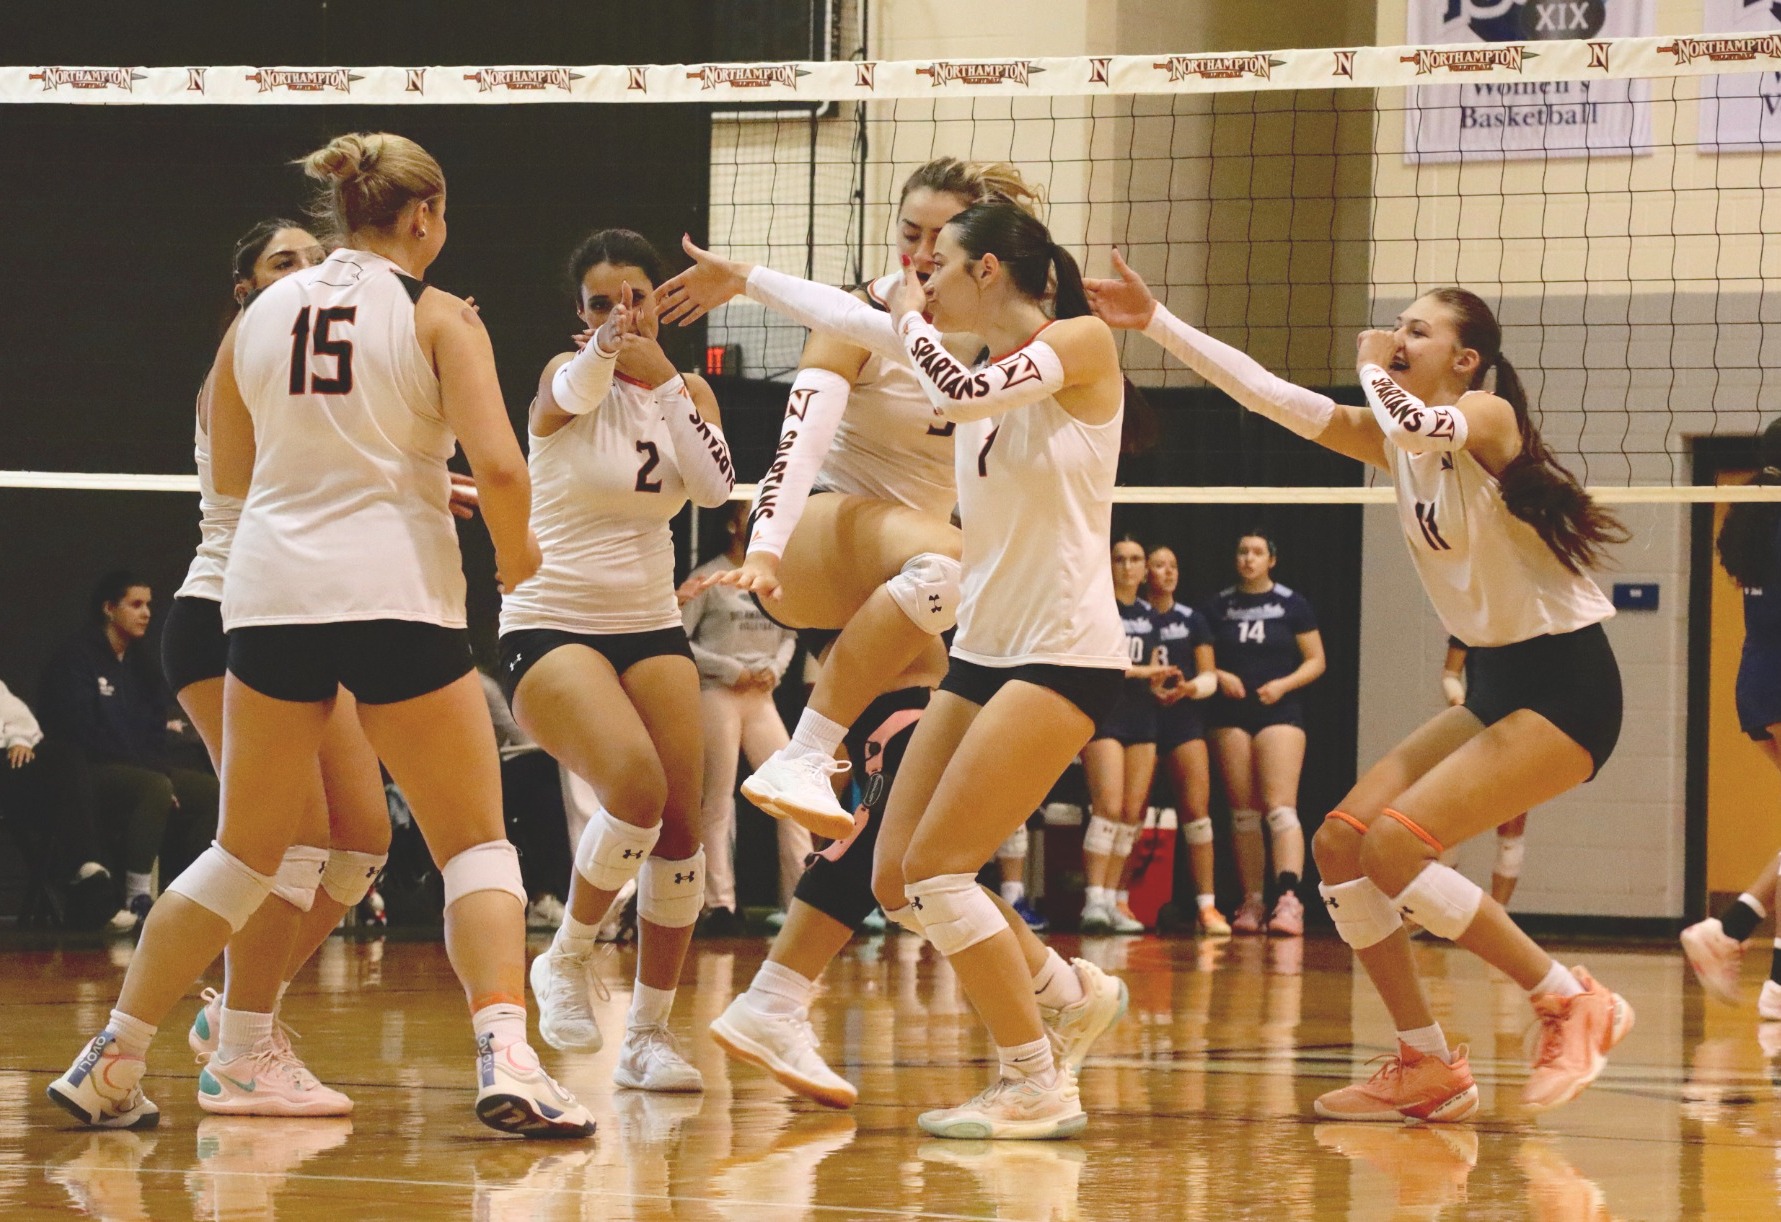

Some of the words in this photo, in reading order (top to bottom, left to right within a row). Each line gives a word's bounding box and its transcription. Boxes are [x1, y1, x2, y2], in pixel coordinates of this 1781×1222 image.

[1535, 2, 1590, 32] XIX
[1169, 54, 1272, 82] NORTHAMPTON
[1332, 51, 1357, 80] N
[1415, 46, 1525, 75] NORTHAMPTON
[1587, 43, 1612, 72] N
[42, 67, 134, 94] NORTHAMPTON
[186, 68, 206, 96] N
[257, 68, 356, 94] NORTHAMPTON
[405, 68, 427, 96] N
[479, 68, 572, 94] NORTHAMPTON
[627, 67, 650, 94] N
[700, 64, 799, 91] NORTHAMPTON
[855, 63, 877, 92] N
[932, 61, 1031, 87] NORTHAMPTON
[1089, 58, 1112, 87] N
[1473, 81, 1590, 96] Womens
[1460, 102, 1598, 129] Basketball
[289, 305, 357, 396] 15
[911, 336, 990, 400] SPARTANS
[996, 353, 1043, 391] N
[784, 388, 820, 422] N
[1371, 377, 1425, 432] SPARTANS
[1426, 410, 1455, 442] N
[634, 439, 662, 493] 2
[1415, 501, 1452, 550] 11
[1238, 620, 1266, 644] 14
